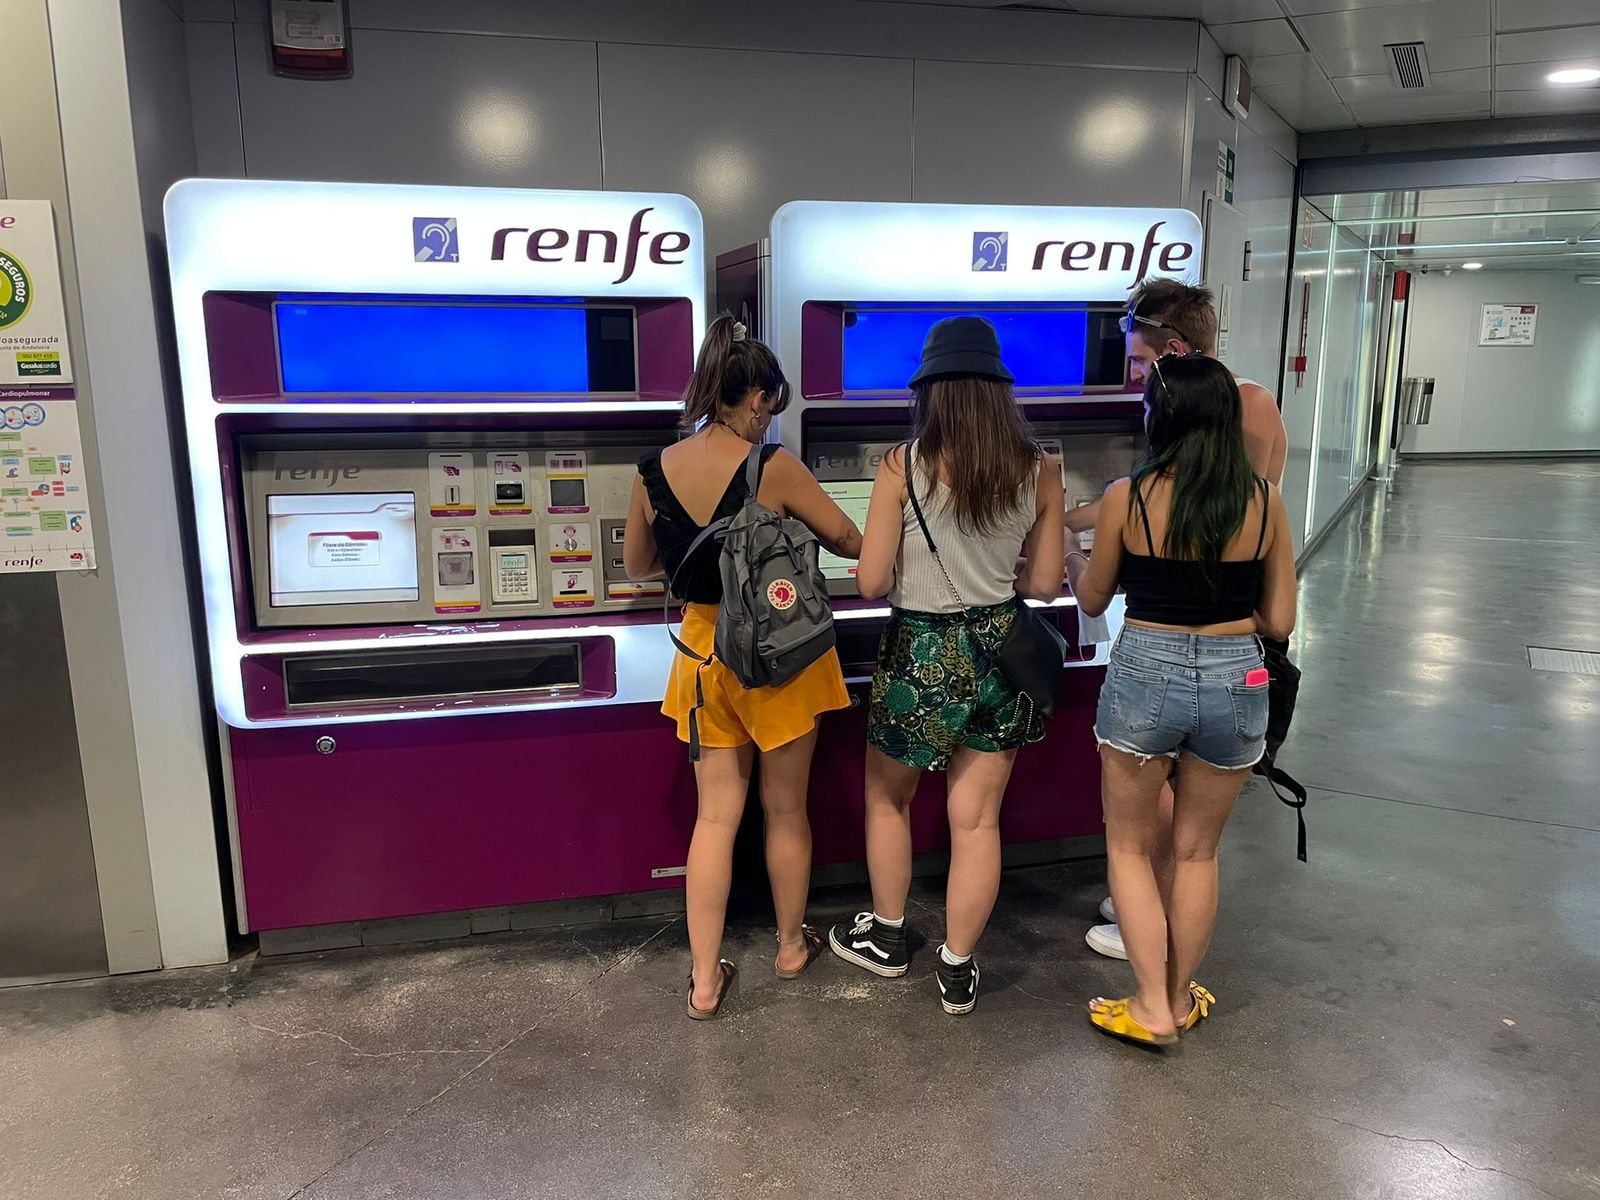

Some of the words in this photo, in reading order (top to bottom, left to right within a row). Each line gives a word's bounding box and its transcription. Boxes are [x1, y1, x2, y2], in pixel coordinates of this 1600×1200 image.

[491, 207, 691, 285] renfe
[1031, 221, 1193, 290] renfe
[0, 336, 59, 346] oasegurada
[4, 555, 43, 568] renfe
